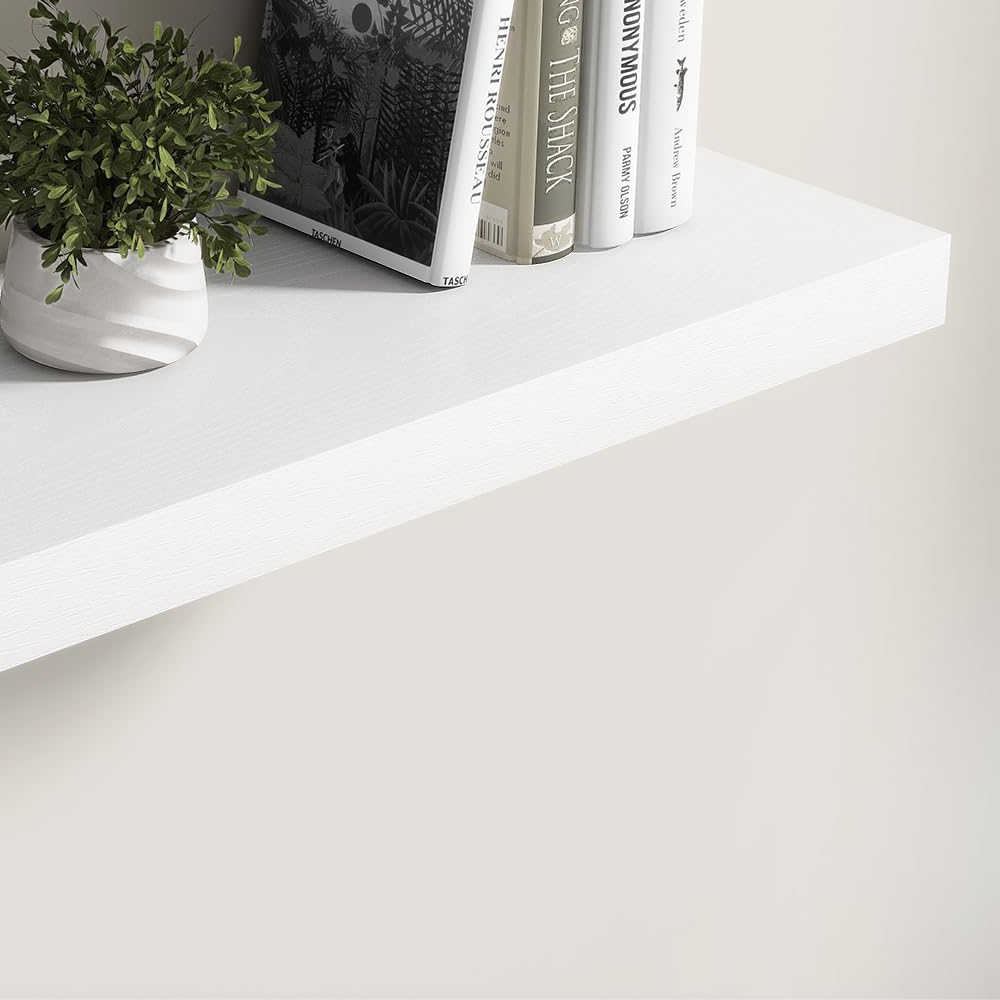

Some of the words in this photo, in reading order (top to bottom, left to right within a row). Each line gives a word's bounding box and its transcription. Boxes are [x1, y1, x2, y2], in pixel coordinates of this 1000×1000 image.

[489, 17, 510, 84] HENRI
[548, 47, 581, 104] THE
[469, 91, 498, 205] ROUSSEAU
[545, 106, 579, 195] SHACK
[621, 146, 632, 182] PARMY
[672, 126, 684, 169] Andrew
[619, 184, 630, 219] OLSON
[670, 172, 681, 208] Brown
[311, 228, 342, 248] TASCHEN
